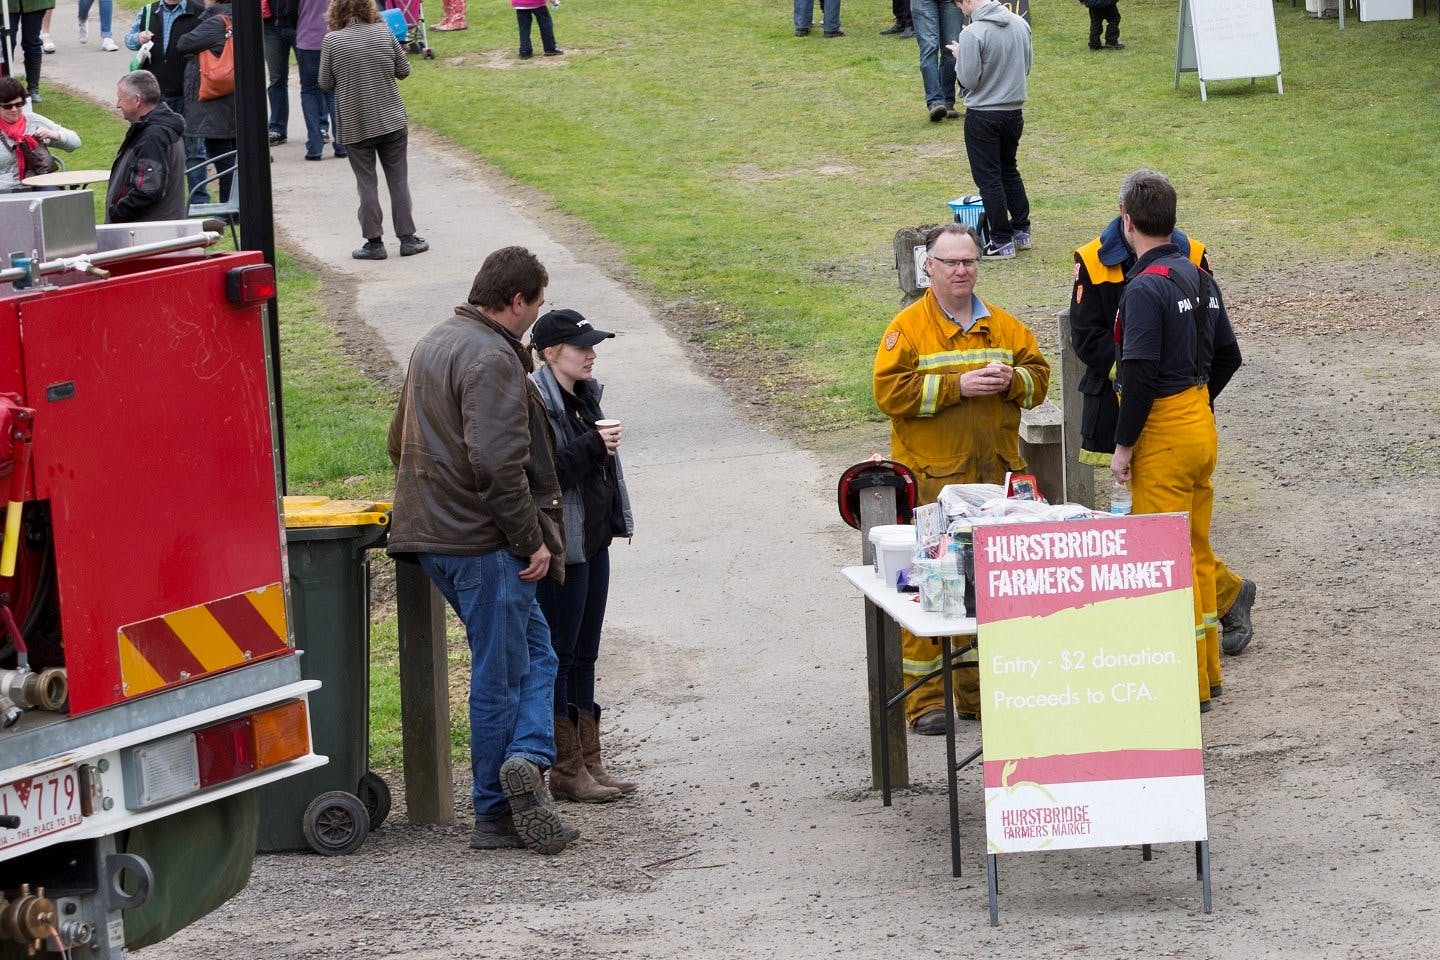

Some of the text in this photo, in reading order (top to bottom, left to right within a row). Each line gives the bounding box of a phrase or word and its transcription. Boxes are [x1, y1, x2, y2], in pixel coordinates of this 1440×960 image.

[984, 529, 1127, 563] HURSTBRIDGE
[988, 560, 1175, 598] FARMERS MARKET
[992, 655, 1041, 678] Entry
[1060, 648, 1086, 671] $2
[1091, 647, 1182, 668] donation.
[994, 682, 1158, 710] Proceeds to CFA.
[33, 774, 75, 820] 779
[17, 828, 31, 839] THE
[33, 820, 54, 835] PLACE
[56, 817, 66, 827] TO
[69, 814, 77, 823] BE
[1001, 805, 1090, 826] HURSTBRIDGE
[1004, 822, 1092, 839] FARMERS MARKET
